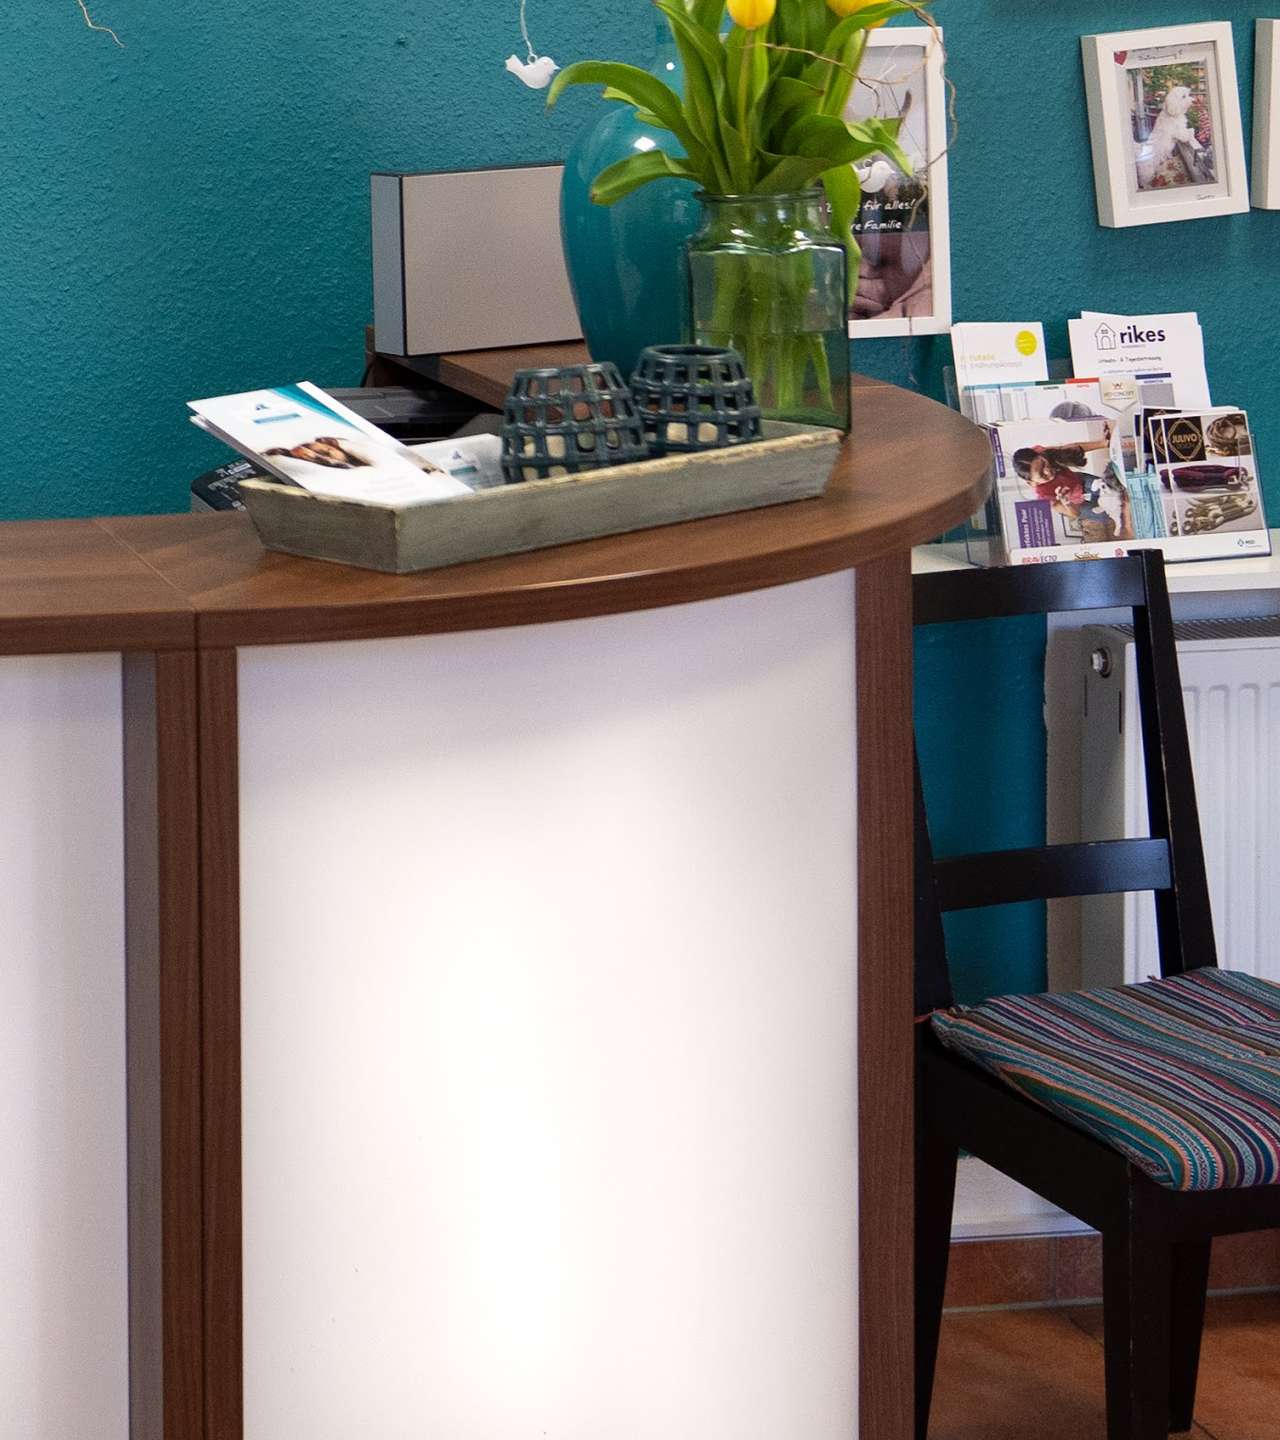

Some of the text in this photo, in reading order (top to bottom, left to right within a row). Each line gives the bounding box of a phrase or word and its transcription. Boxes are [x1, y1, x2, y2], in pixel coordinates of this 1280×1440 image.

[864, 198, 916, 212] für alles!
[864, 220, 903, 230] Familie
[1120, 325, 1166, 344] rikes
